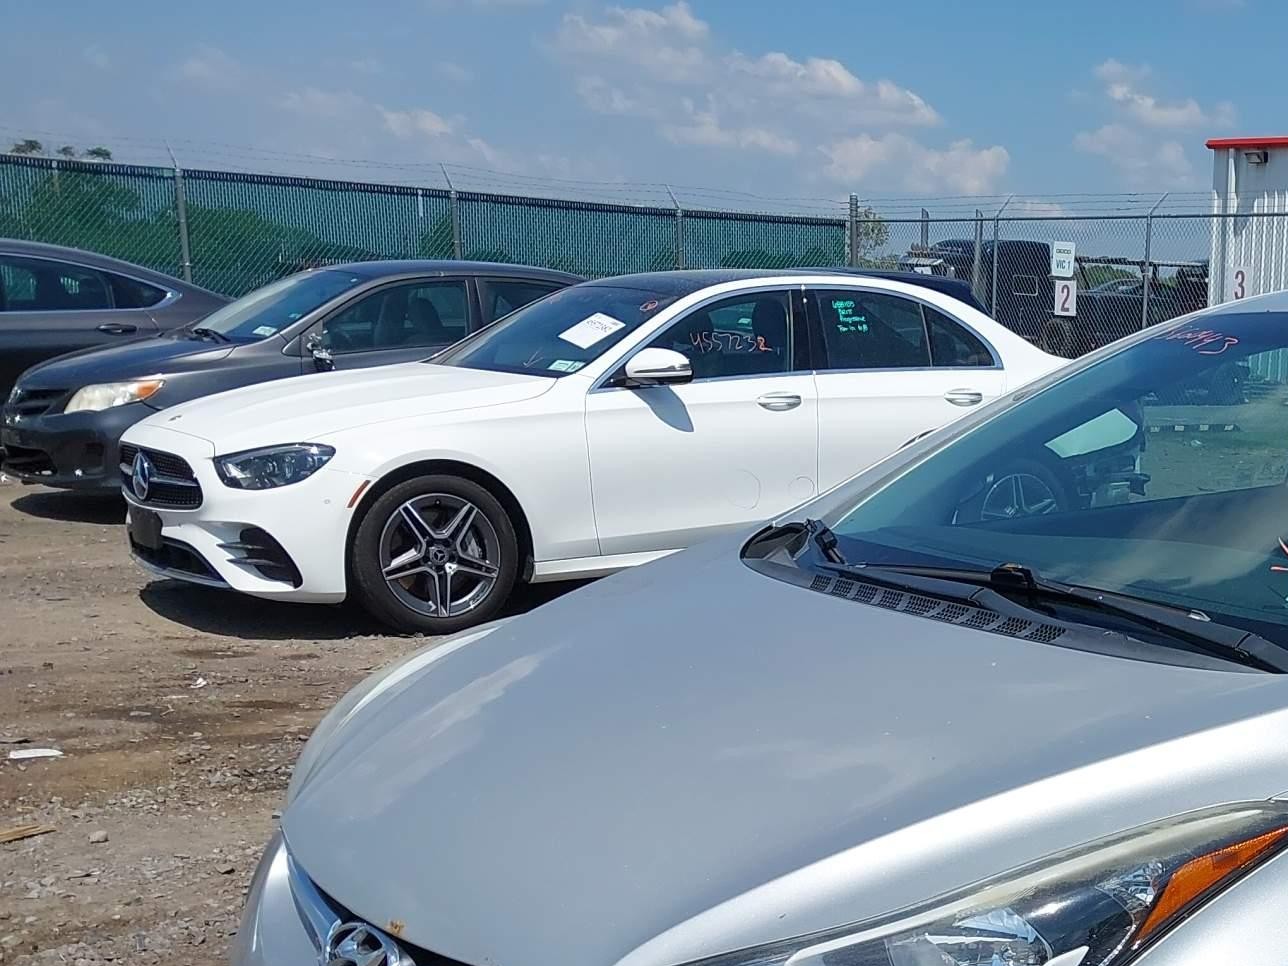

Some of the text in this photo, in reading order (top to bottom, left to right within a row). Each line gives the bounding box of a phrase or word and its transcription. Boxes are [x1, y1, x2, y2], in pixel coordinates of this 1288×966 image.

[1056, 259, 1071, 271] VIC 1
[1061, 284, 1070, 313] 2
[1234, 270, 1246, 300] 3
